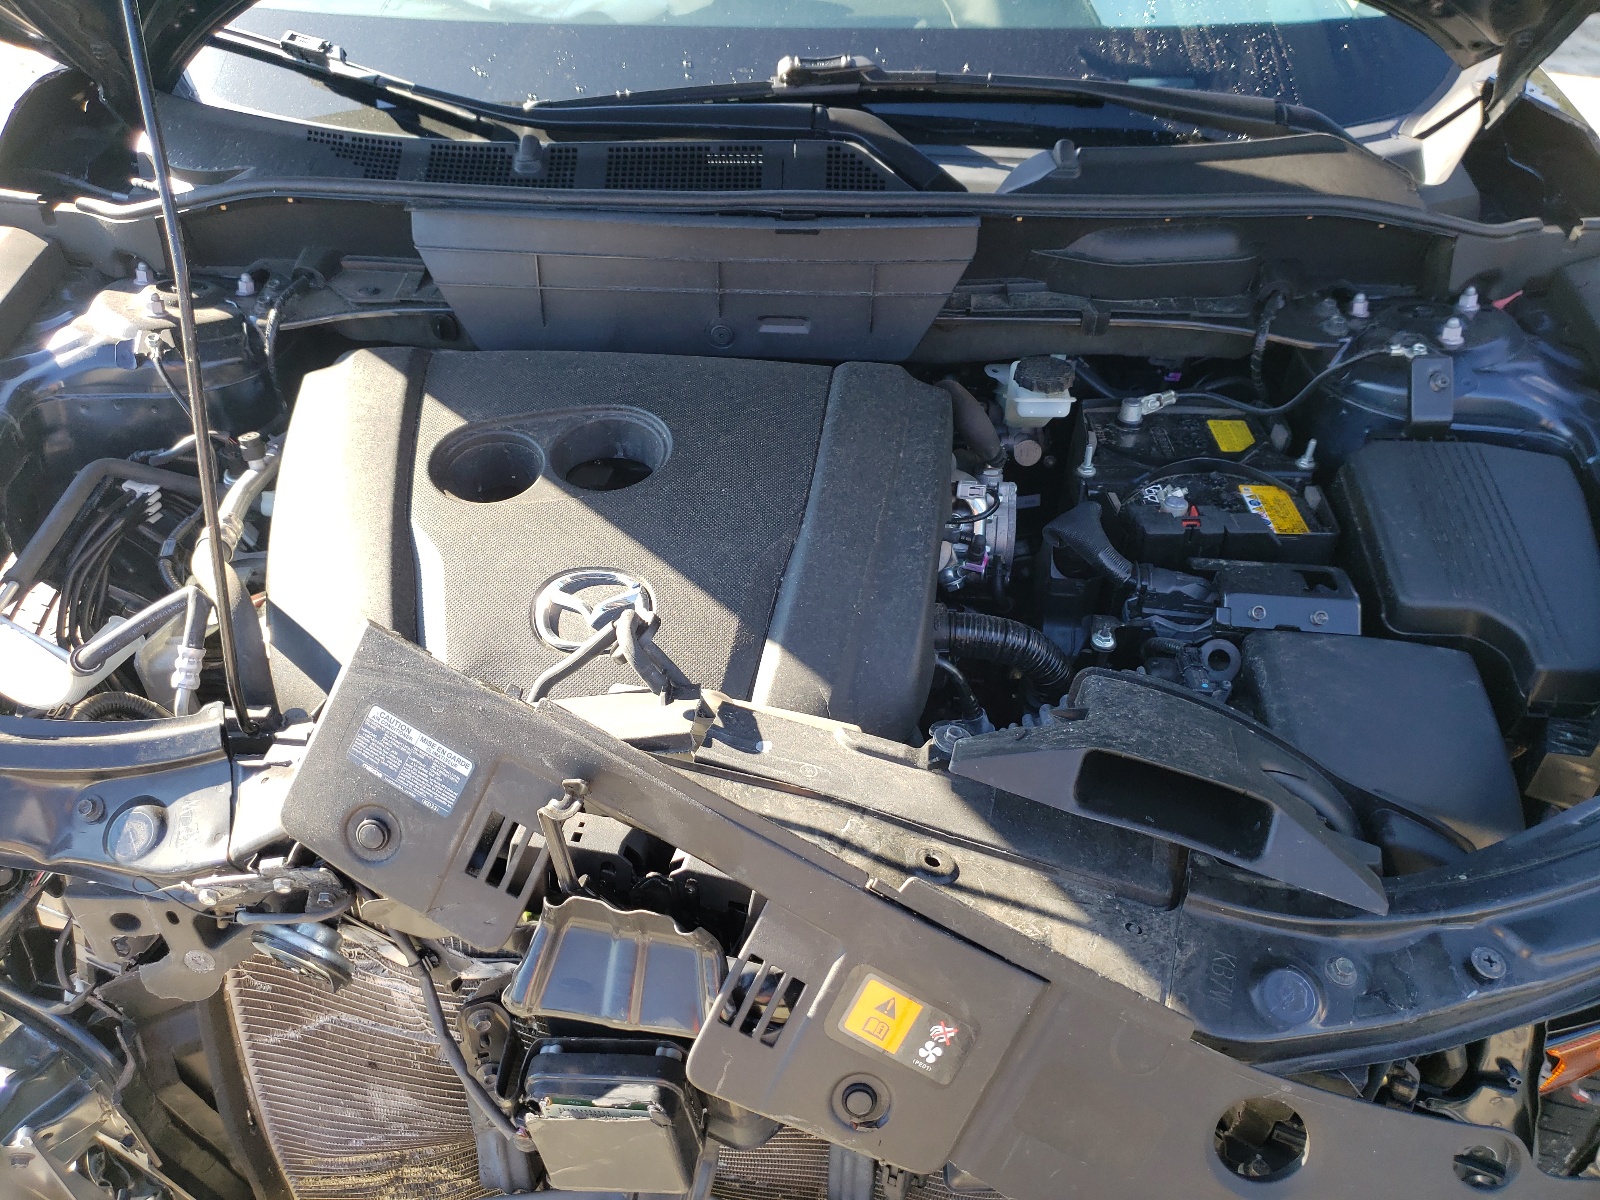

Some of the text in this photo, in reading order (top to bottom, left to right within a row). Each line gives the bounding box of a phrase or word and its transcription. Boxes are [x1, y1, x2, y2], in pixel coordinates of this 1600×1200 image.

[372, 715, 413, 741] AIR CONDITIONER
[380, 711, 412, 734] CAUTION
[421, 736, 470, 769] MISE EN GARDE
